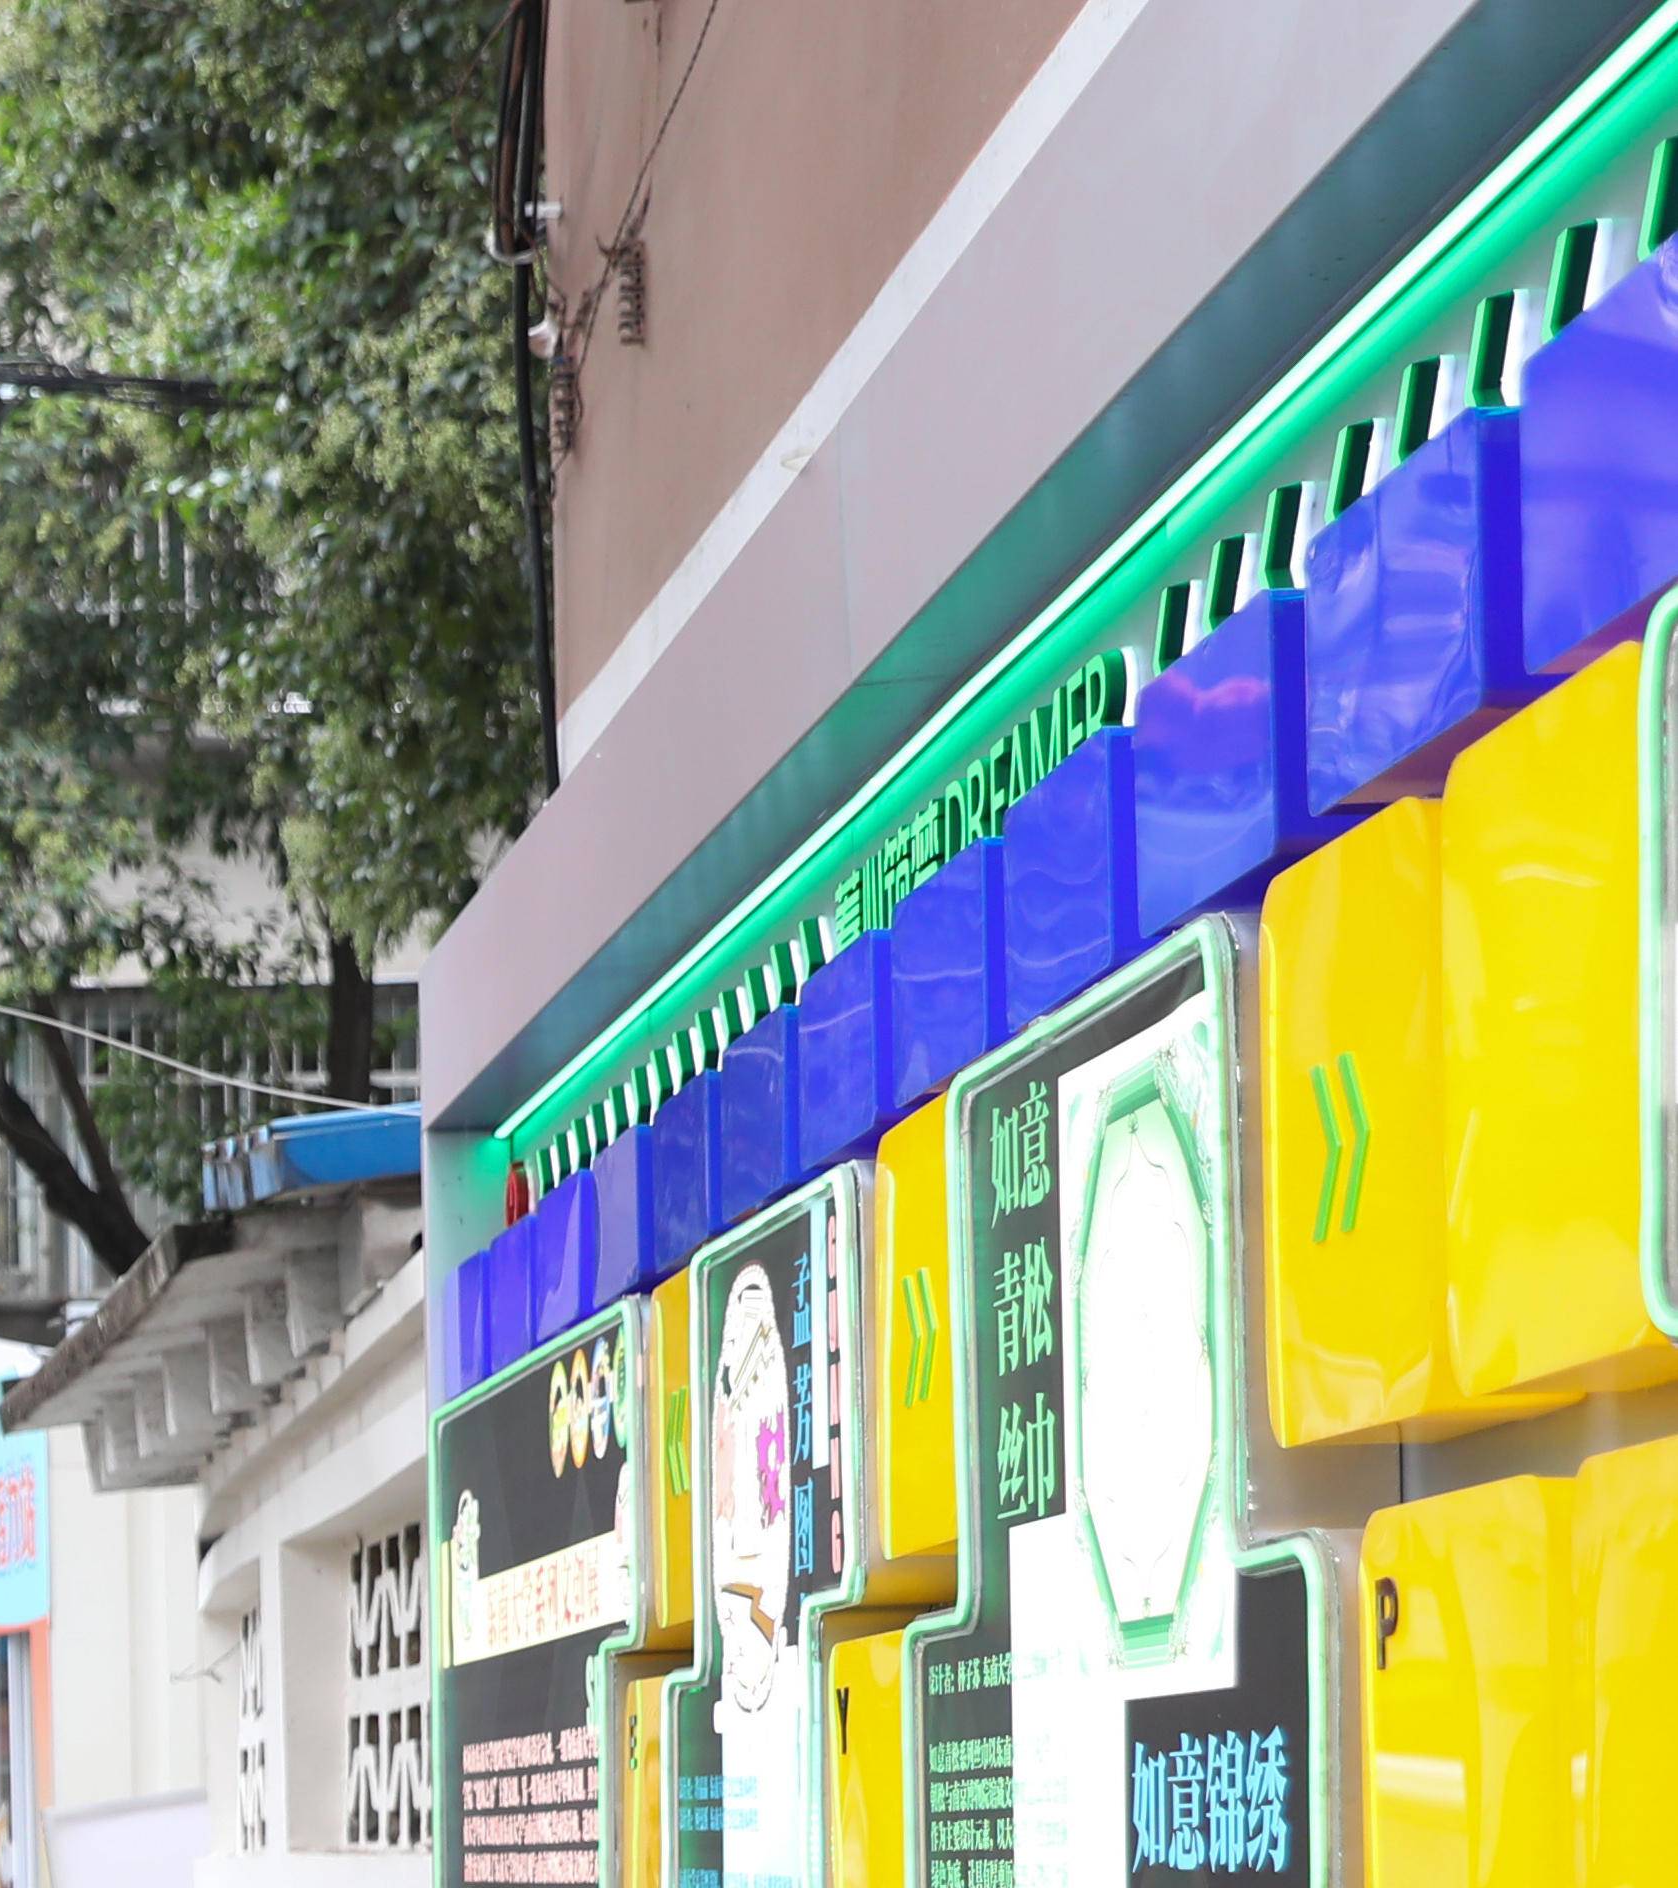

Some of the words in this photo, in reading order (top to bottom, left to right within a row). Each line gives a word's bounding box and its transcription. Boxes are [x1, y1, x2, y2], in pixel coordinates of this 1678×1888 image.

[945, 648, 1109, 862] DREAMER
[990, 1080, 1051, 1229] 如意
[994, 1240, 1053, 1378] 青松
[791, 1252, 815, 1577] 孟芳图
[996, 1393, 1060, 1521] 丝巾
[1376, 1578, 1400, 1670] P
[1132, 1727, 1291, 1874] 如意锦绣
